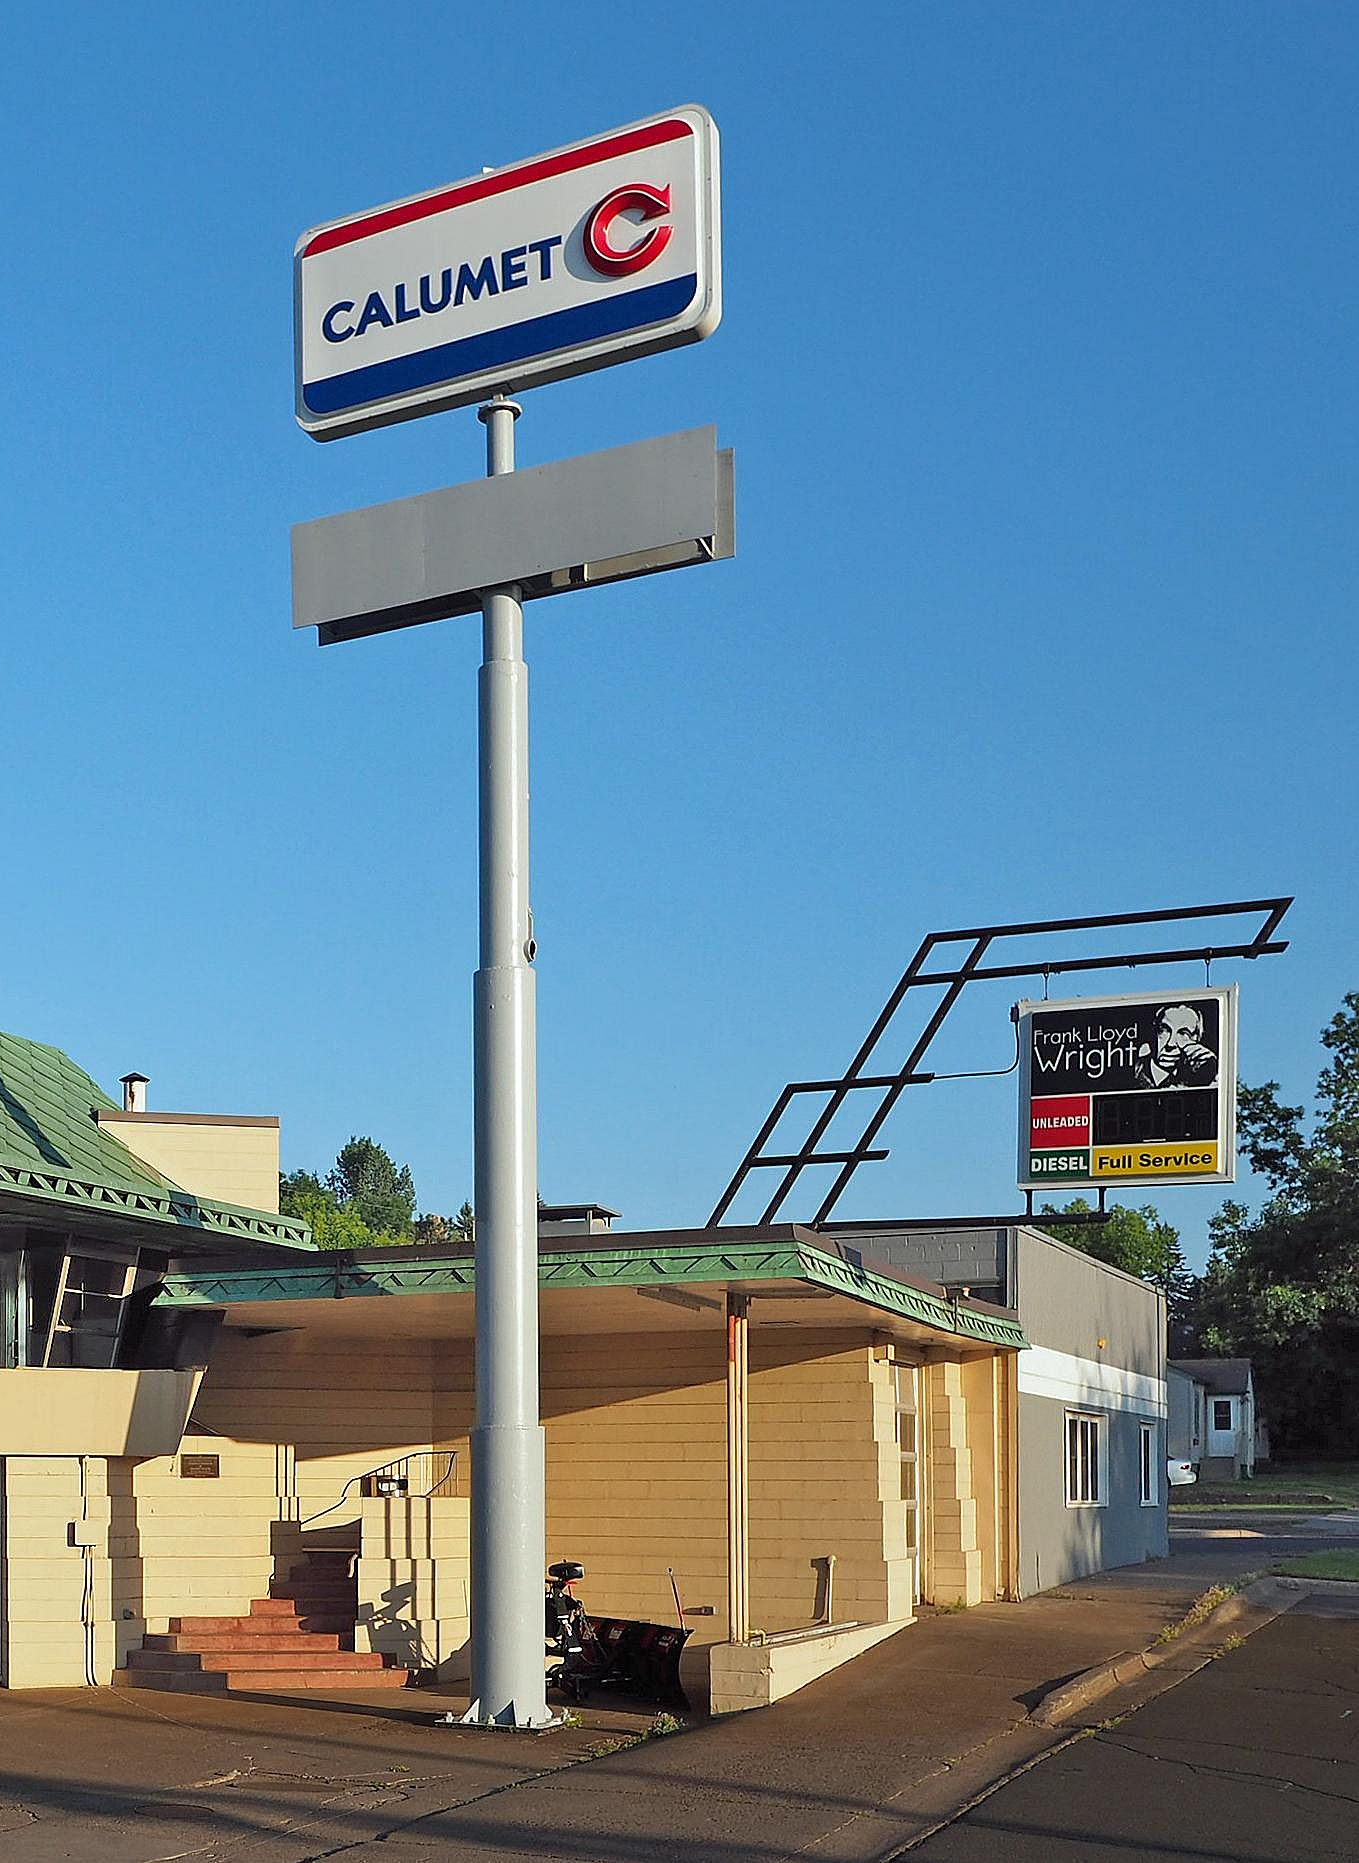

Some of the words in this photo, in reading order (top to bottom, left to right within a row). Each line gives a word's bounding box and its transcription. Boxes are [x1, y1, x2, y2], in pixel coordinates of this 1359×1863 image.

[322, 235, 562, 343] CALUMET
[583, 183, 673, 276] C
[1034, 1027, 1082, 1045] Frank
[1087, 1023, 1137, 1045] Lloyd
[1034, 1041, 1137, 1078] Wright
[1032, 1115, 1089, 1129] UNLEADED
[1031, 1156, 1088, 1172] DIESEL
[1098, 1155, 1132, 1169] Full
[1140, 1153, 1212, 1167] Service
